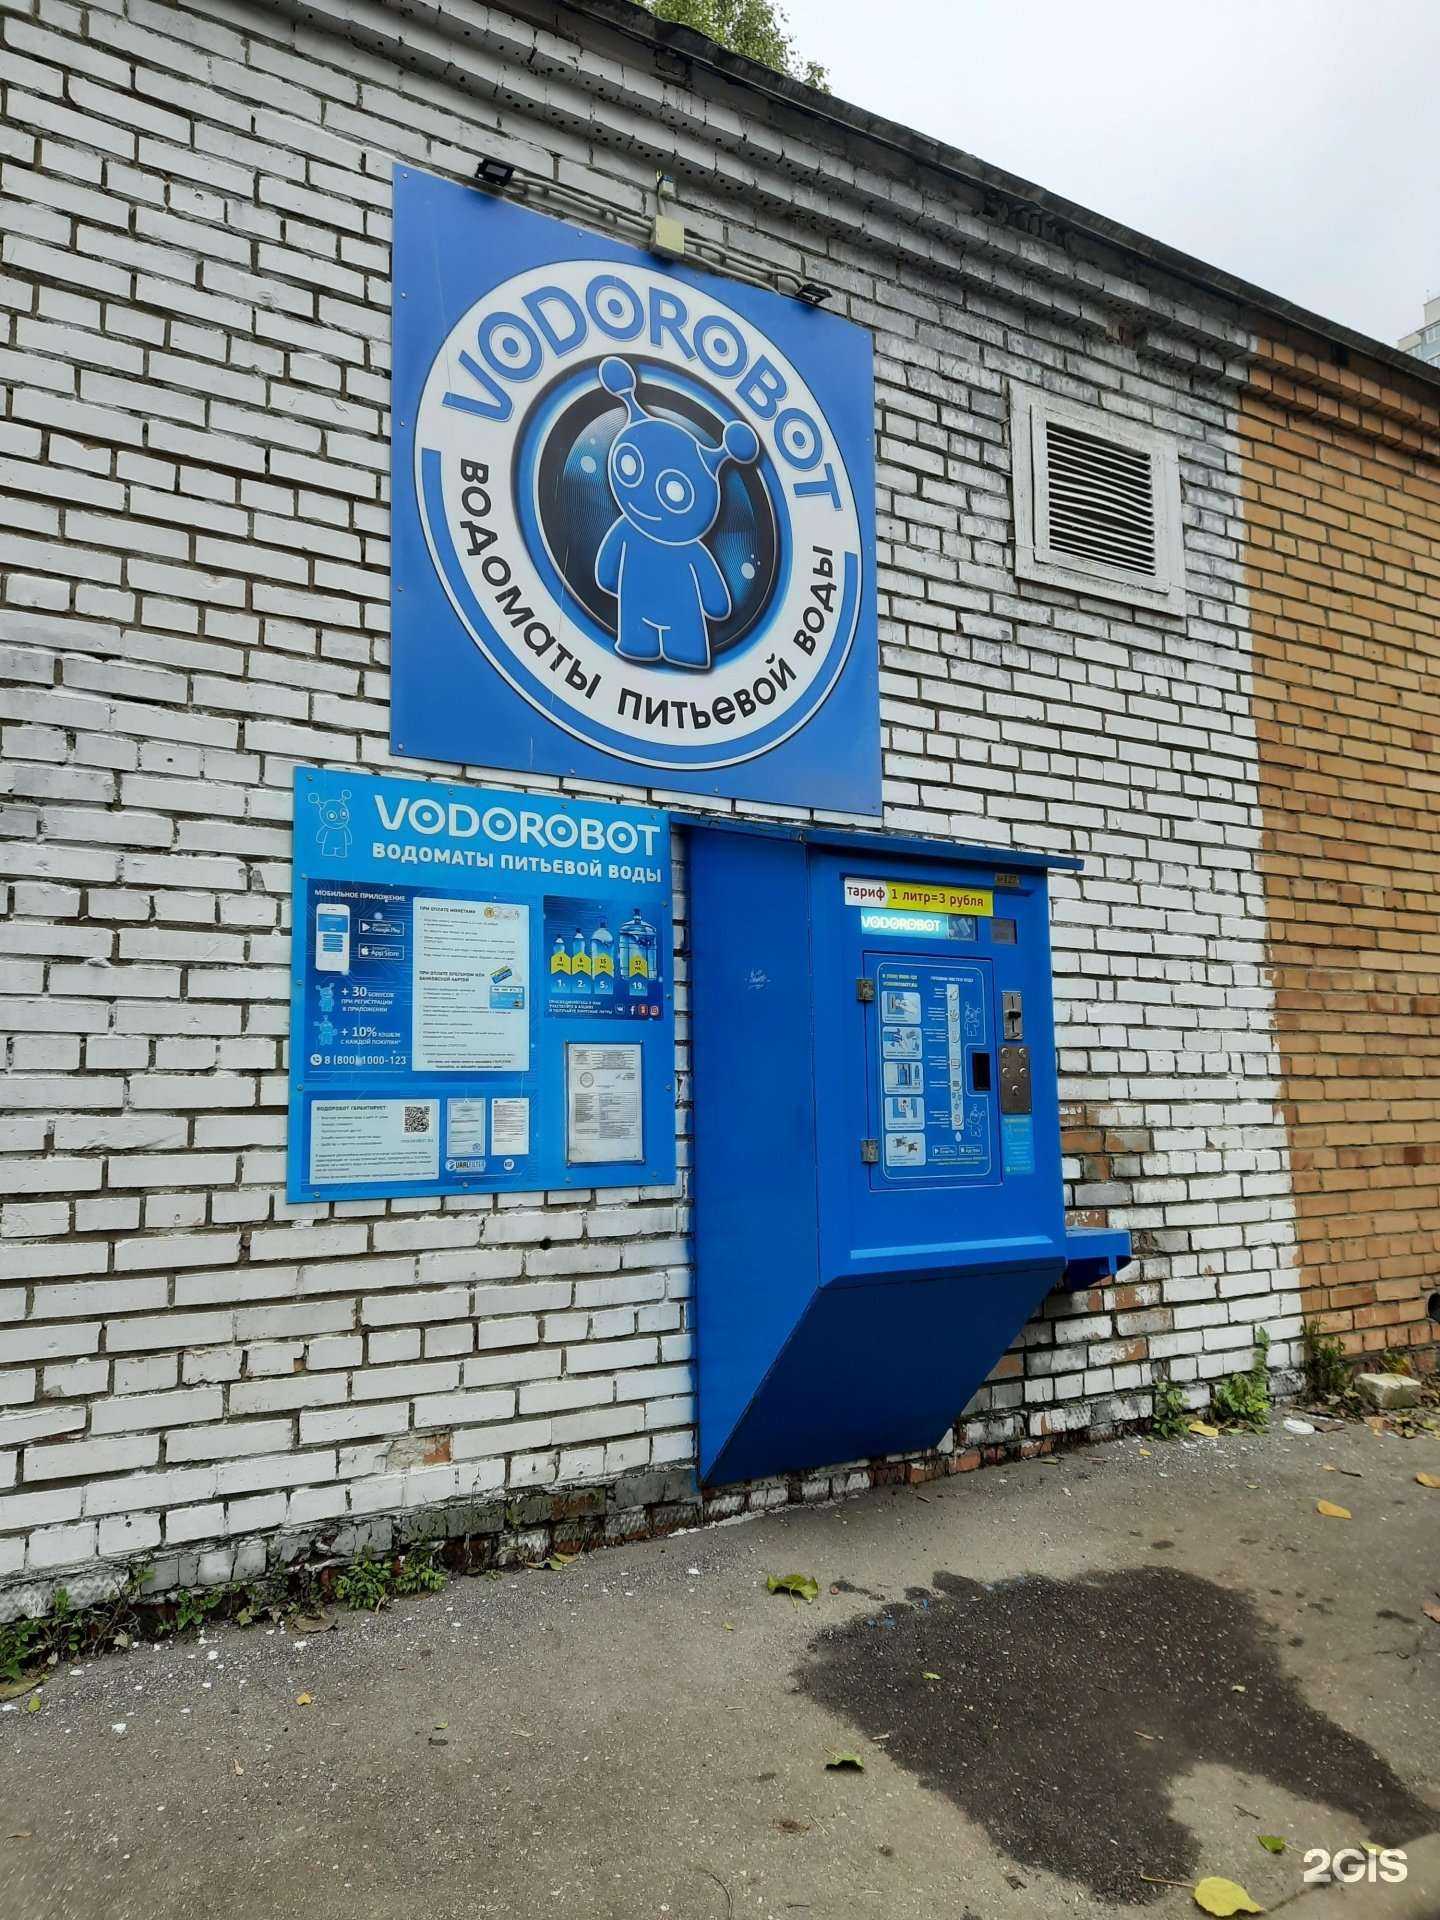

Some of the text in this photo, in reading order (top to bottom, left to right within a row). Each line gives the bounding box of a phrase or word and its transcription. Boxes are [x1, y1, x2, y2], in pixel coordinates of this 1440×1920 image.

[441, 274, 844, 512] VODOROBOT
[374, 795, 661, 856] VODOROBOT
[372, 842, 662, 884] ВОДОМАТЫ ПИТЬЕВОЙ ВОДЫ
[847, 886, 886, 899] тариф
[891, 889, 898, 899] 1
[950, 895, 984, 907] рубля
[861, 915, 941, 931] VODOROBOT
[352, 986, 367, 997] 30
[352, 1026, 377, 1037] 10%
[324, 1056, 331, 1065] 8
[363, 1056, 407, 1065] 1000-123
